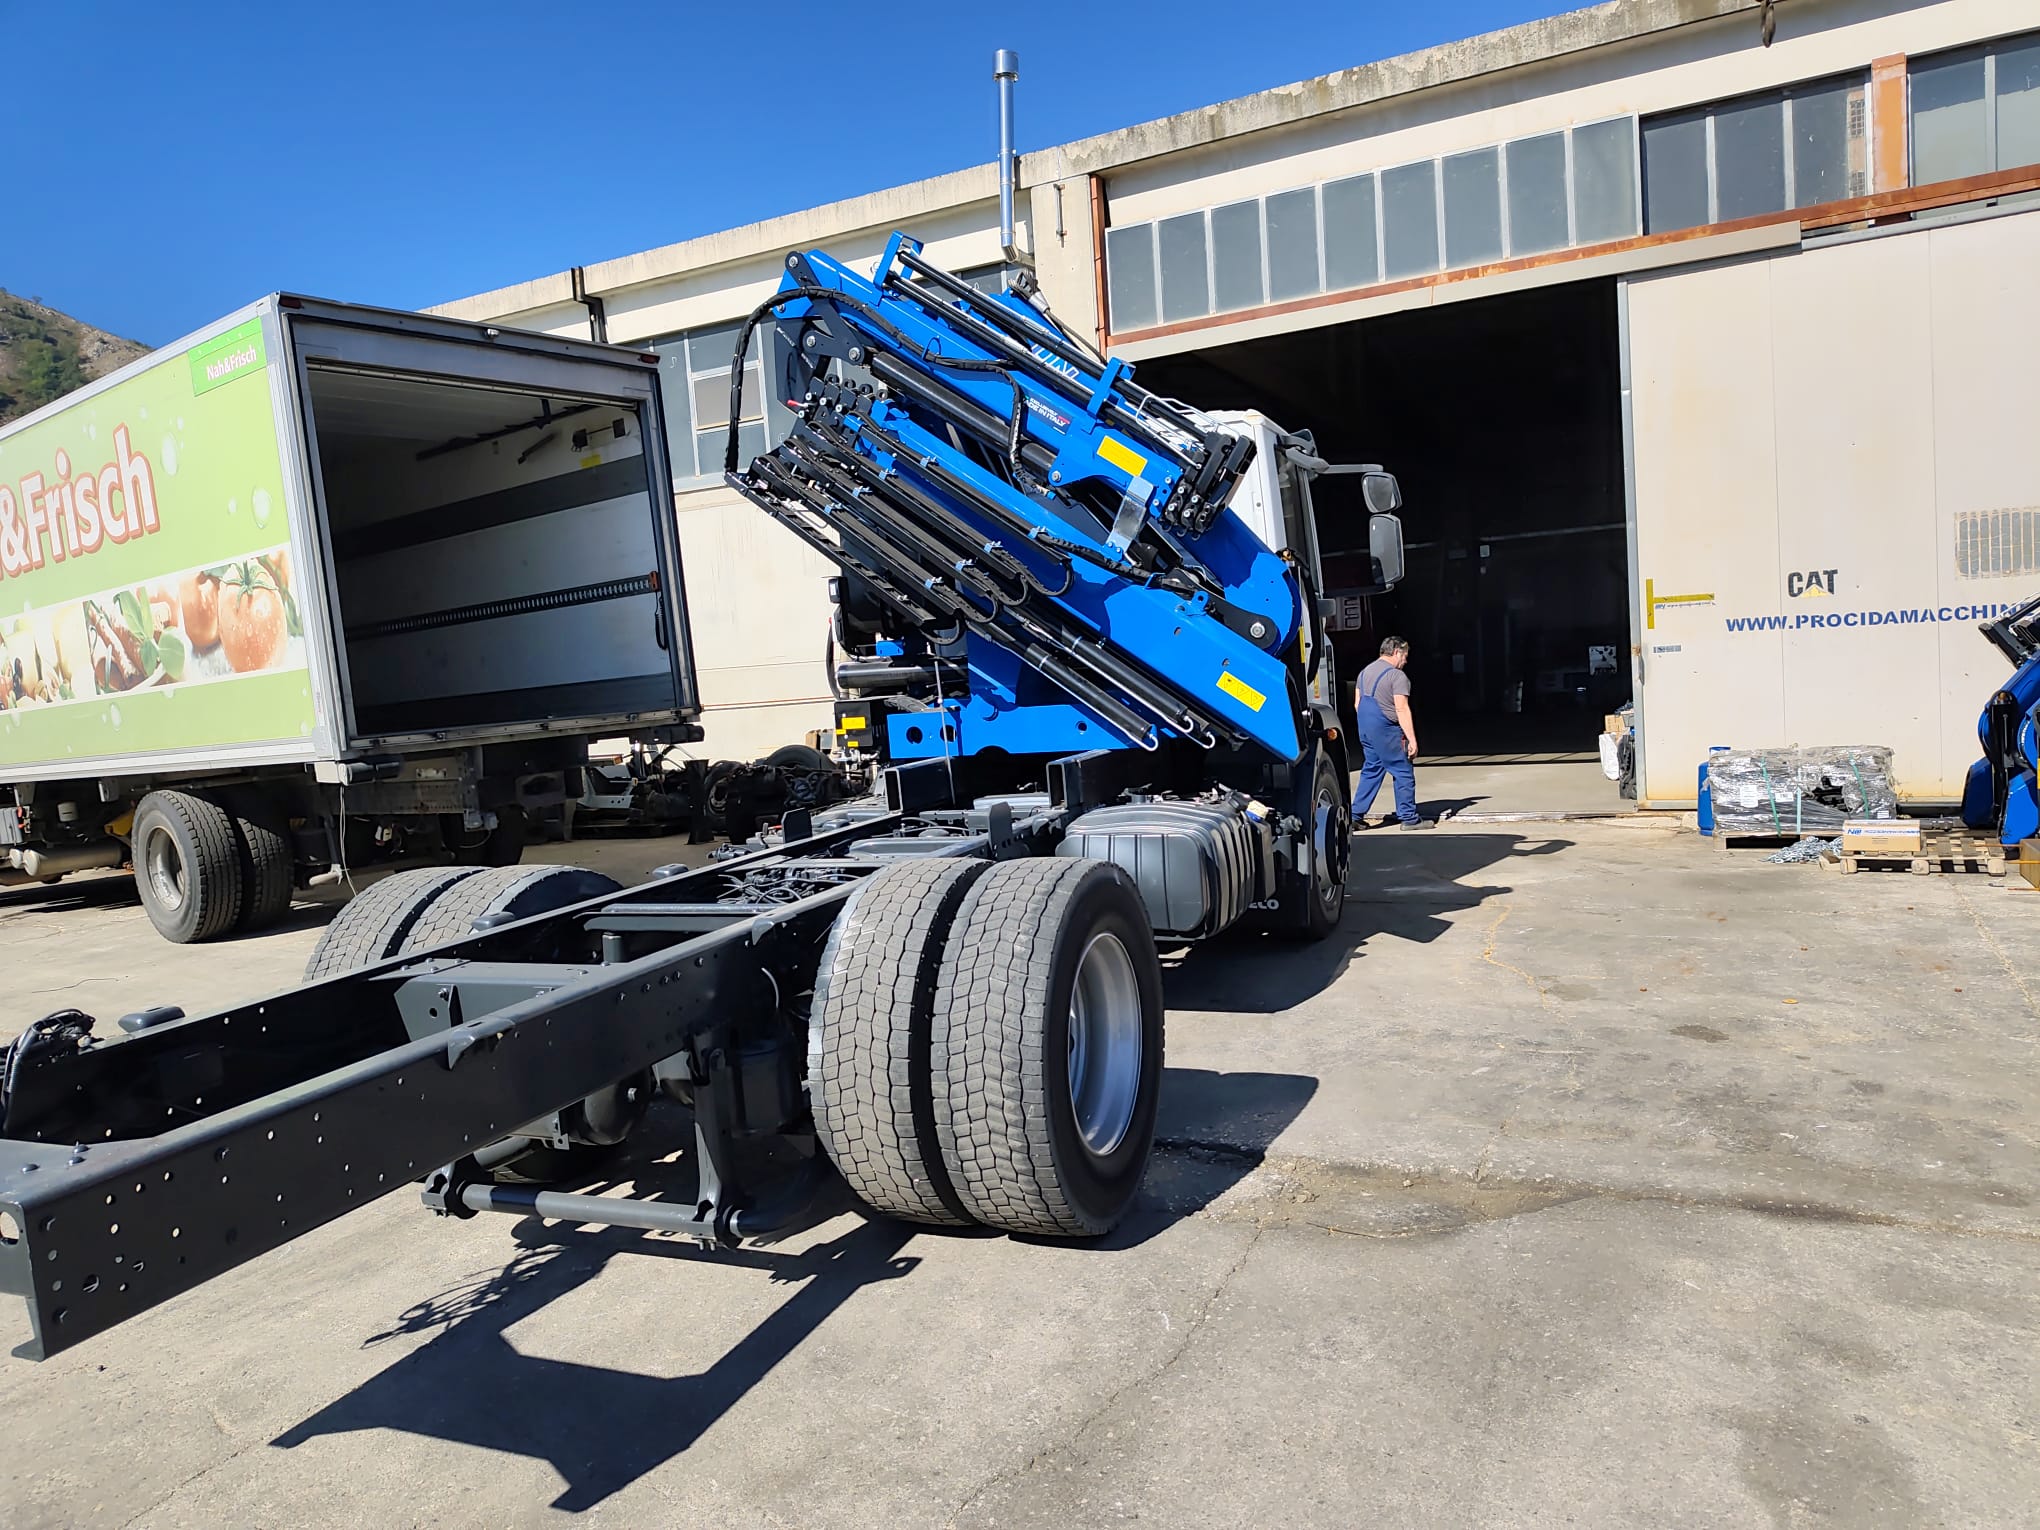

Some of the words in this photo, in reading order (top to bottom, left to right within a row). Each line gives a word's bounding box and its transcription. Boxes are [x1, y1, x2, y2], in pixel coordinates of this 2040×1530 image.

[206, 345, 257, 380] Nah&Frisch
[1038, 407, 1047, 417] IN
[1046, 413, 1066, 427] ITALY
[1787, 569, 1838, 598] CAT
